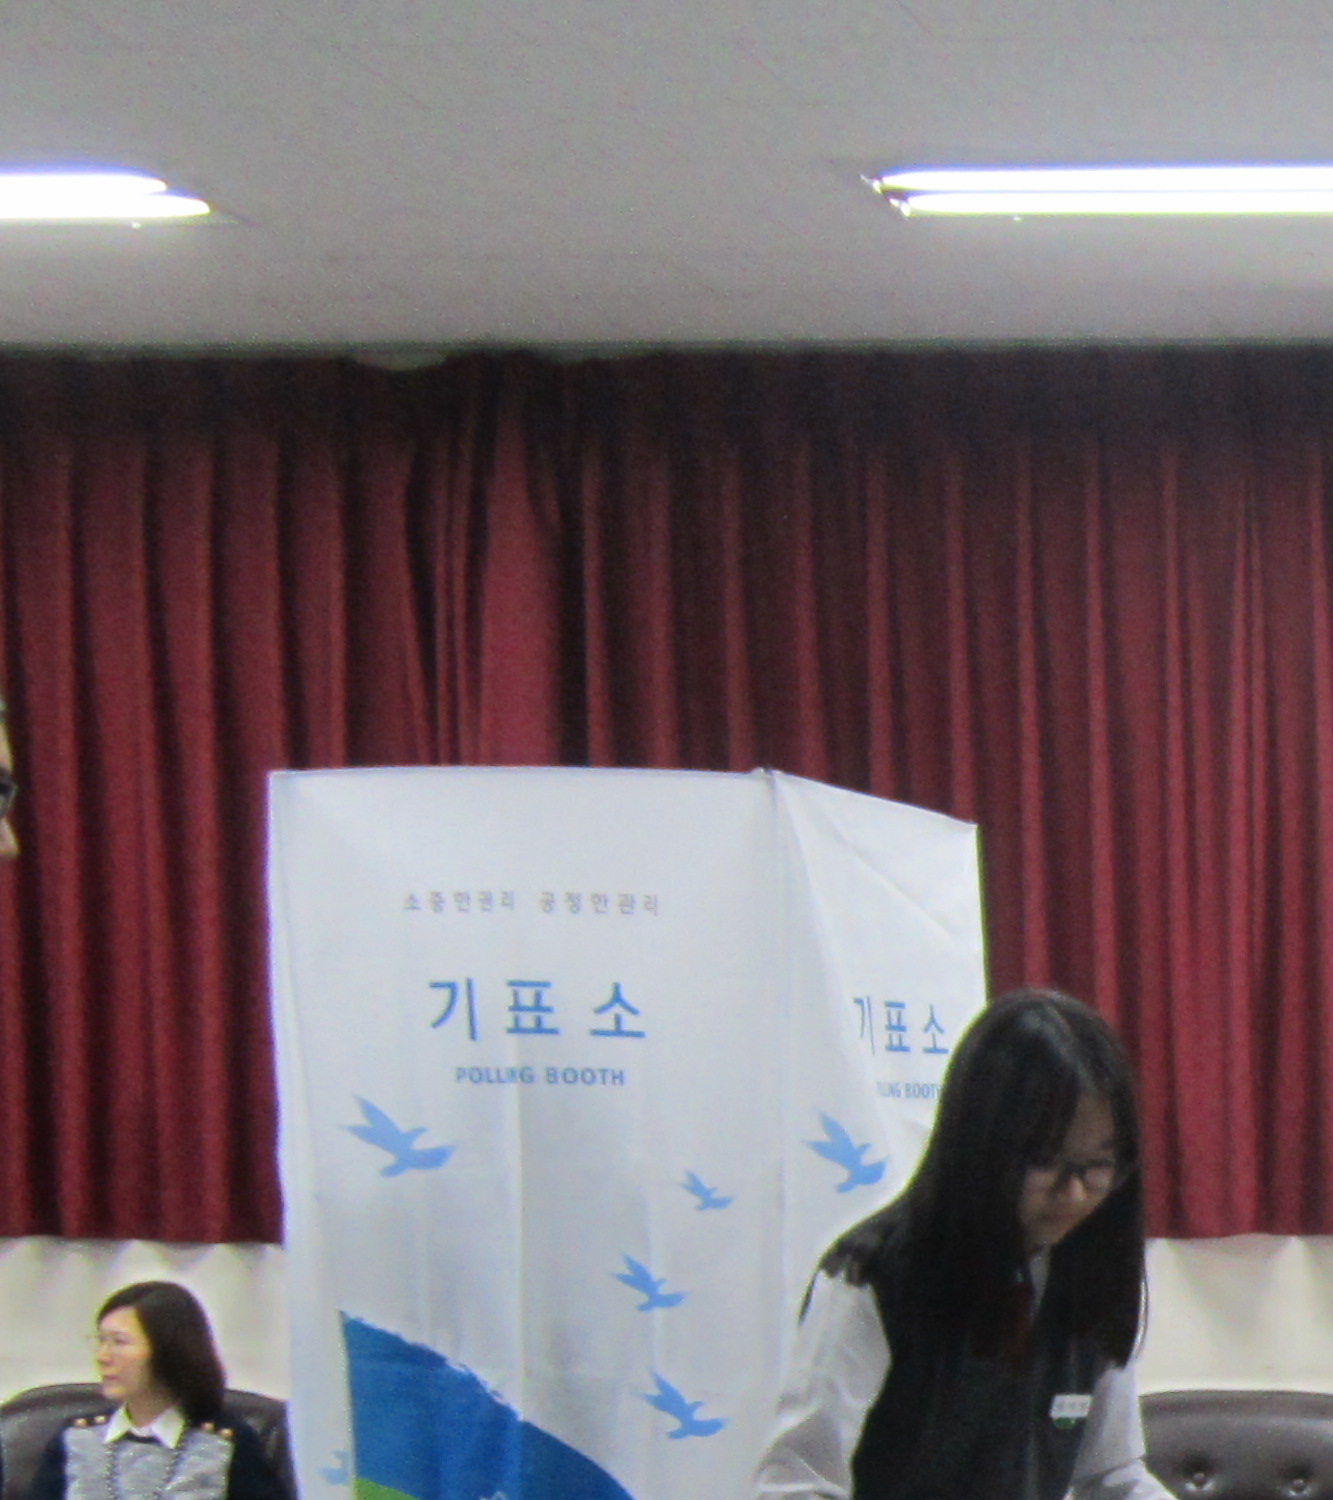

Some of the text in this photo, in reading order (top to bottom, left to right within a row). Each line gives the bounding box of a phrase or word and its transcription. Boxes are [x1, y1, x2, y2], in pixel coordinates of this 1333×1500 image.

[429, 977, 646, 1041] 기표소
[853, 996, 950, 1057] 기표소
[455, 1066, 625, 1086] POLLING BOOTH
